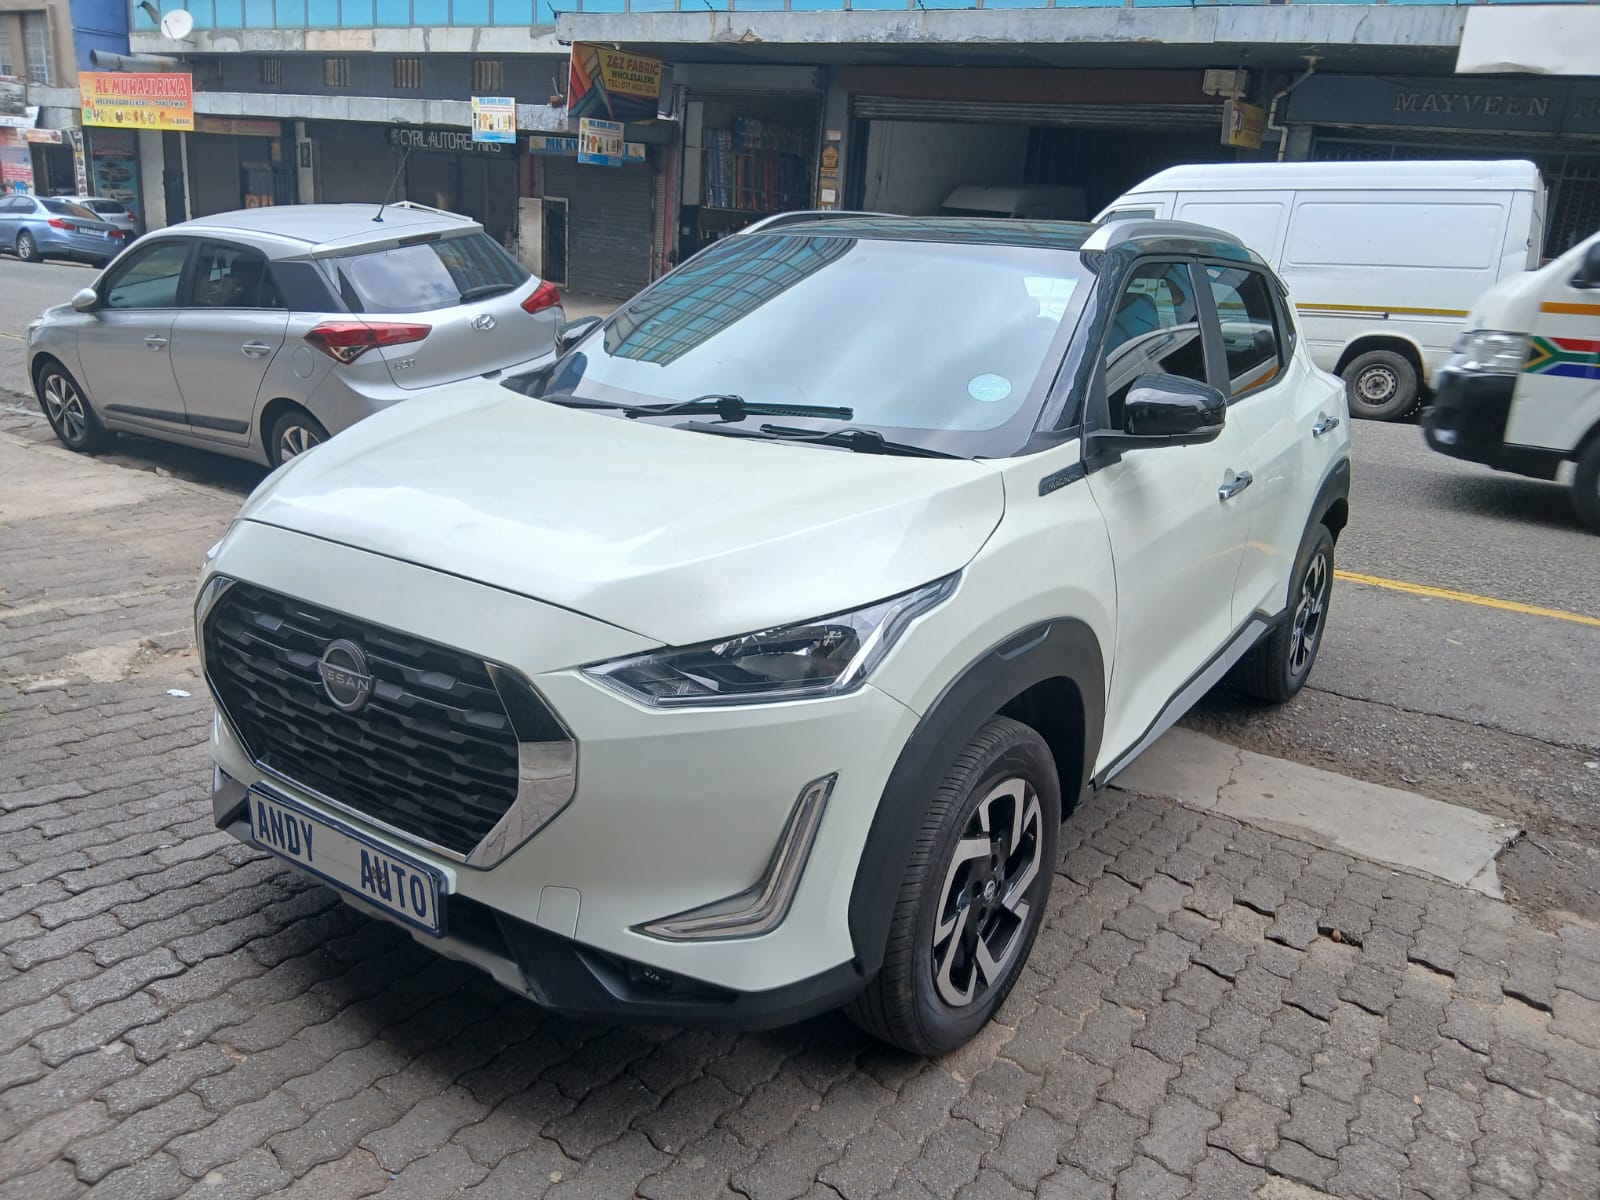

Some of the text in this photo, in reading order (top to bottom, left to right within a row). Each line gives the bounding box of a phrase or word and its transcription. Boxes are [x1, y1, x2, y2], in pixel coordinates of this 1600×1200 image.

[607, 54, 660, 75] Z&Z FABRIC
[95, 77, 109, 94] AL
[611, 70, 655, 85] WHOLESALERS
[1393, 92, 1551, 118] MAYVEEN
[400, 129, 501, 153] CYRIL AUTO REAIRS
[257, 800, 427, 918] ANDY AUTO
